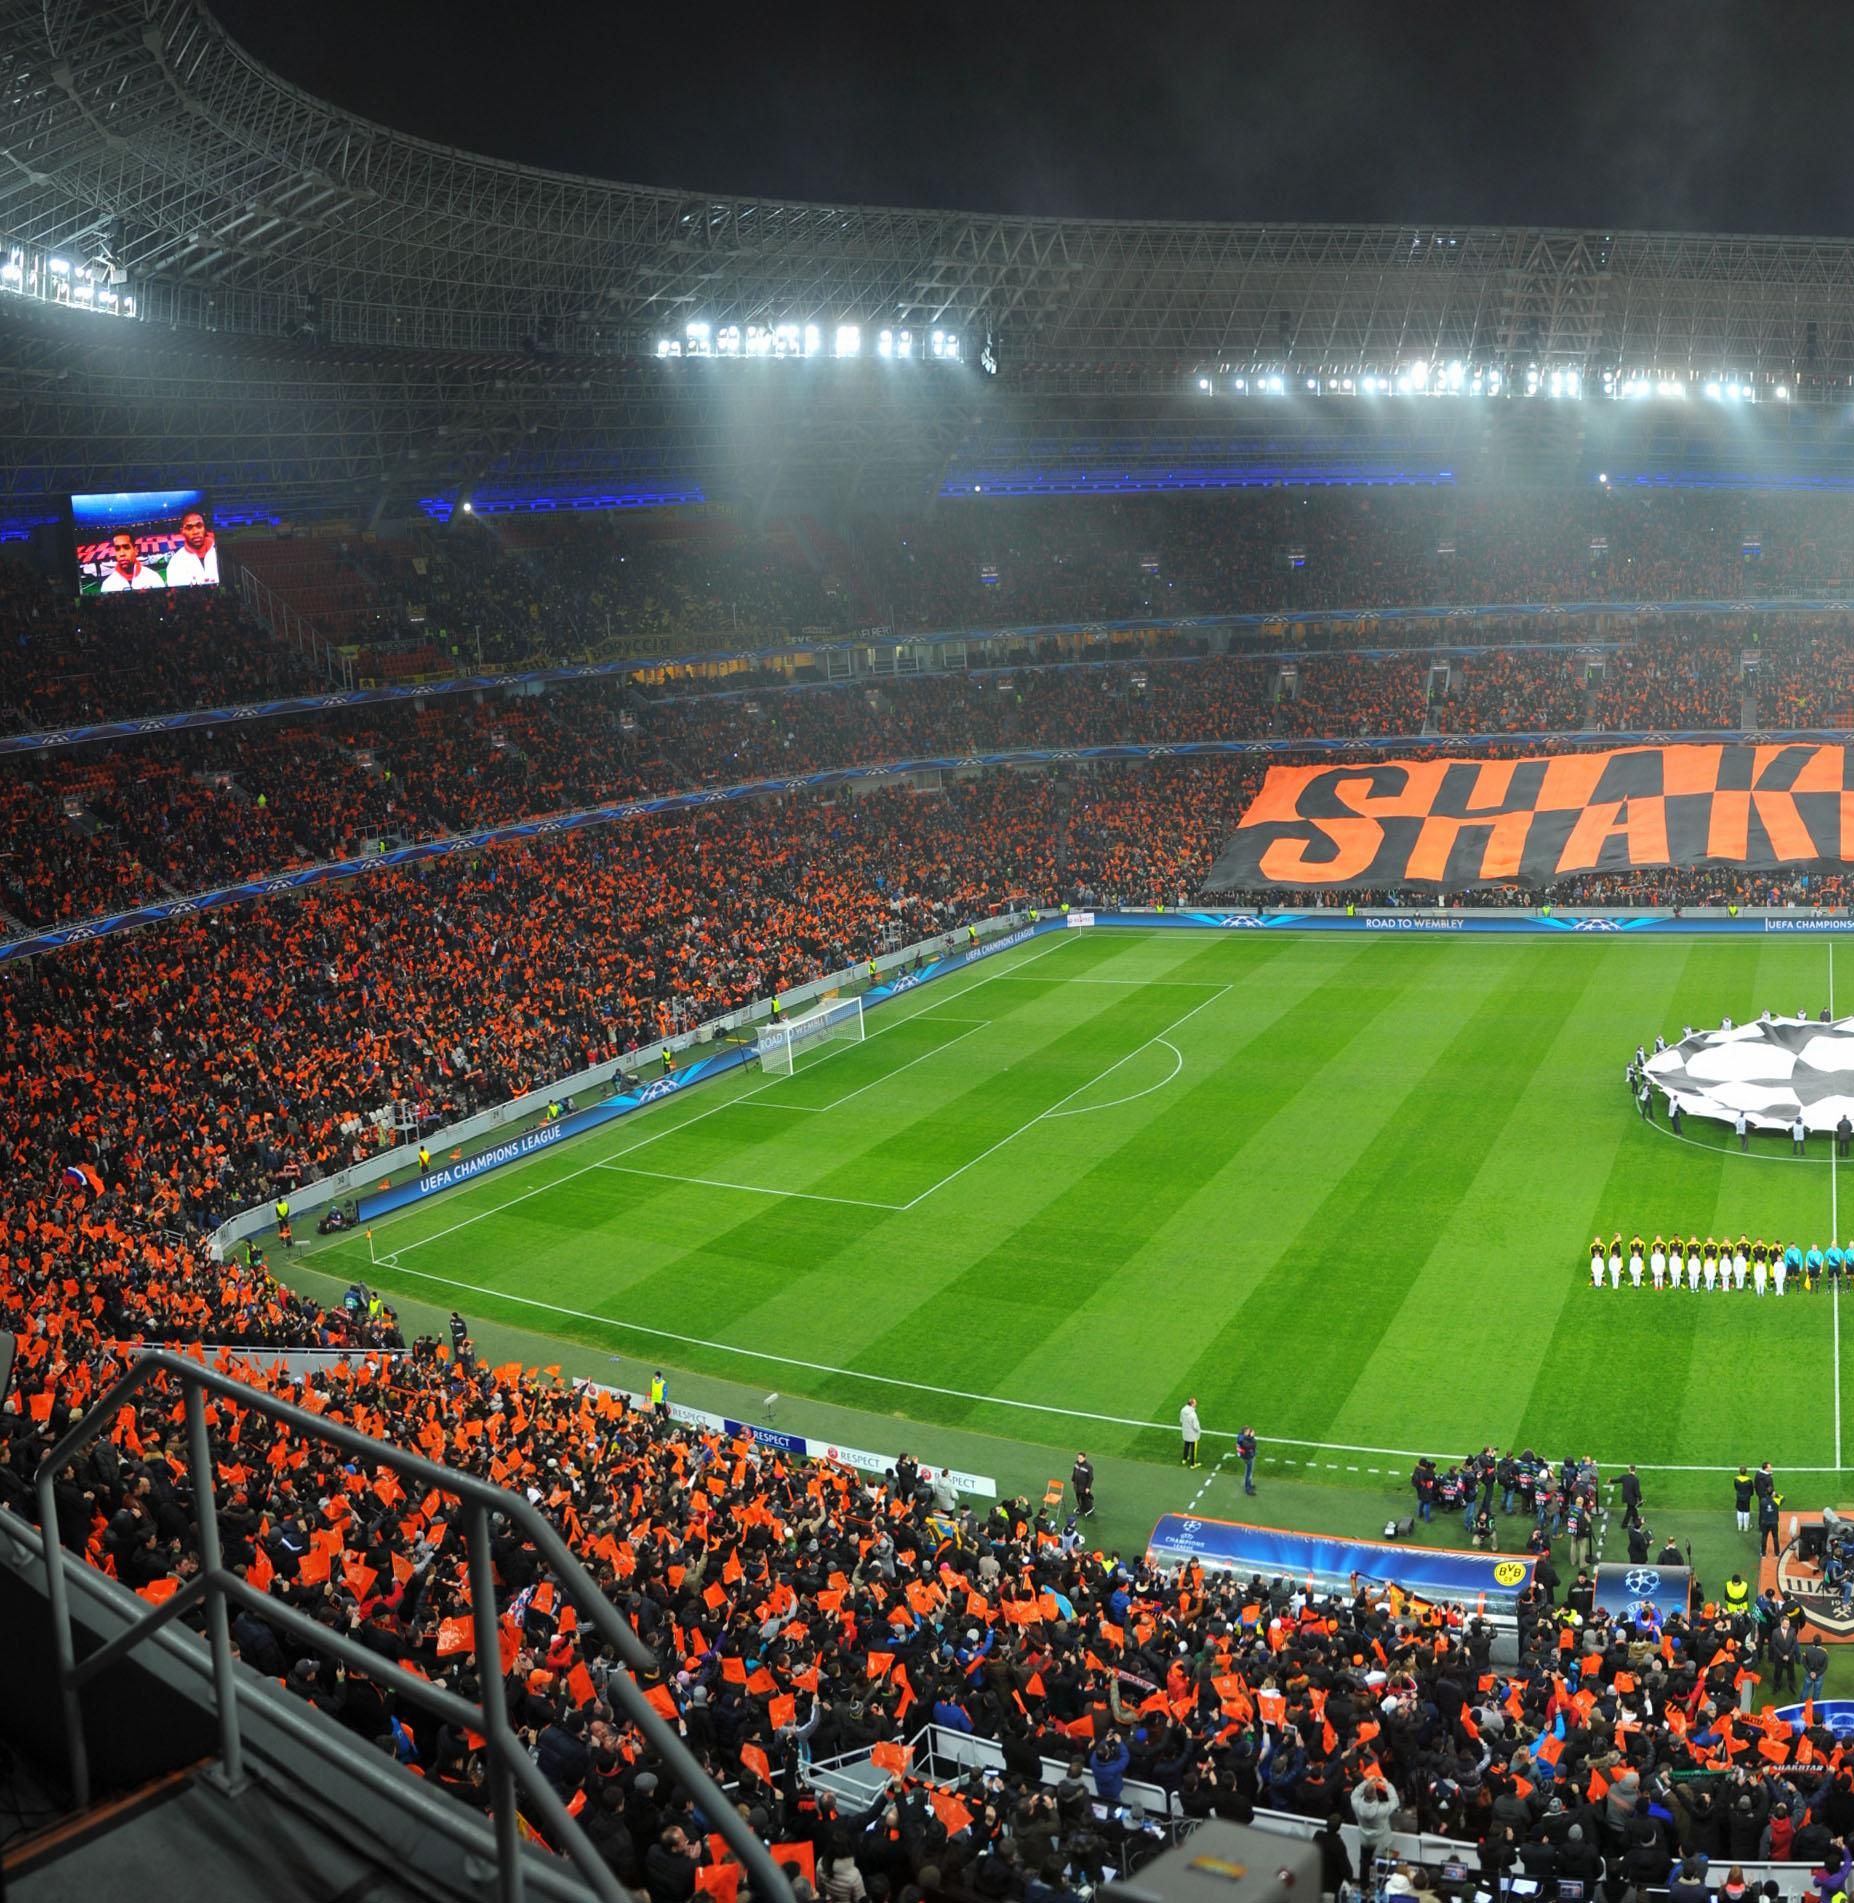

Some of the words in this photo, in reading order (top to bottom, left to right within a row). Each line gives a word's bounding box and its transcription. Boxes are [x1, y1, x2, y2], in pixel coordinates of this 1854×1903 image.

[1366, 918, 1395, 928] ROAD
[1399, 918, 1412, 928] TO
[1414, 919, 1464, 928] WEMBLEY
[1768, 920, 1793, 928] UEFA
[1796, 920, 1852, 928] CHAMPIONS
[965, 947, 981, 962] UEFA
[981, 935, 1014, 956] CHAMPIONS
[1014, 926, 1035, 942] LEAGUE
[760, 1032, 783, 1050] ROAD
[419, 1172, 451, 1193] UEFA
[453, 1142, 519, 1181] CHAMPIONS
[521, 1125, 562, 1152] LEAGUE
[672, 1408, 707, 1424] RESPECT
[753, 1430, 790, 1447] RESPECT
[840, 1451, 880, 1468] RESPECT
[1165, 1536, 1205, 1548] CHAMPIONS
[1498, 1562, 1522, 1578] BVB
